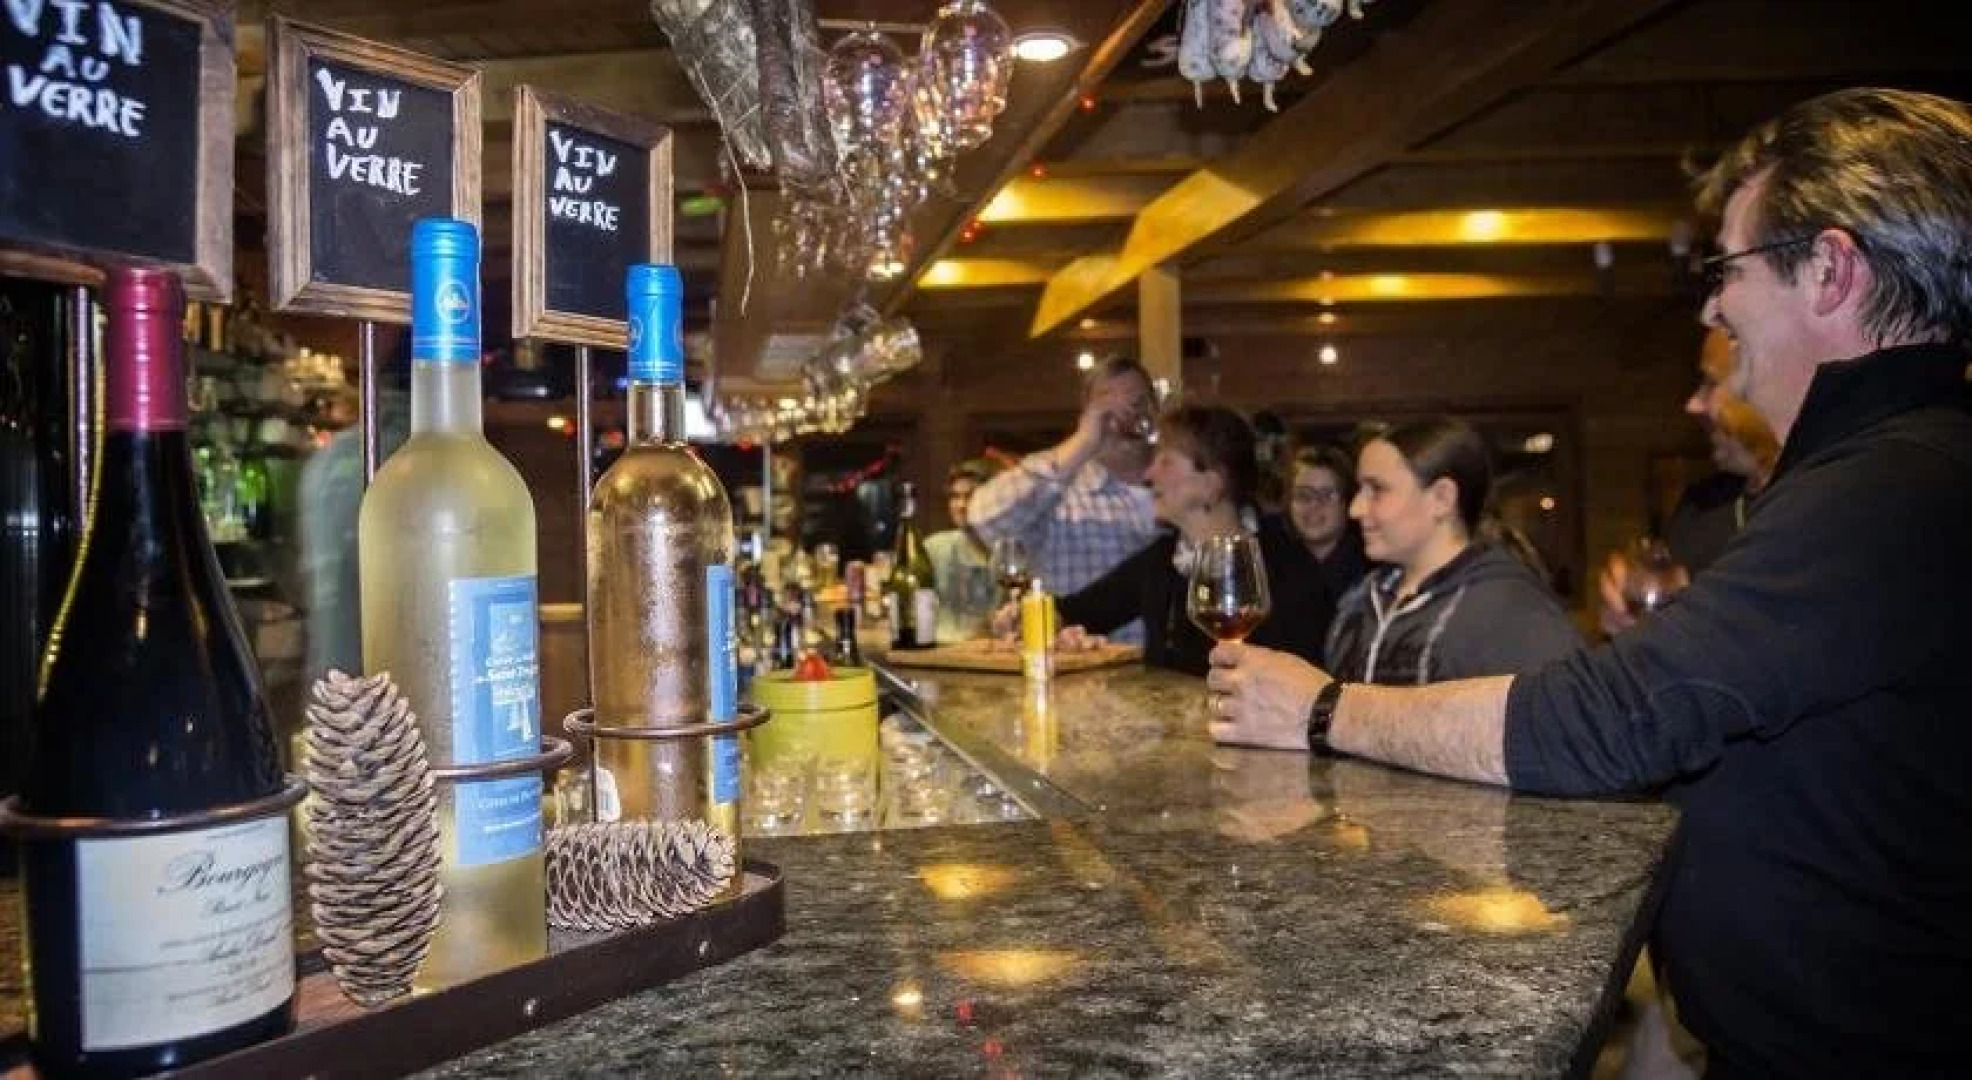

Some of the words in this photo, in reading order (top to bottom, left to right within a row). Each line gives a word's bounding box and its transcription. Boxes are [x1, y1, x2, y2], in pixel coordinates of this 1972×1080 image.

[4, 0, 142, 65] VIN
[41, 44, 110, 82] AU
[8, 65, 147, 136] VERRE
[316, 68, 402, 118] VIN
[326, 116, 379, 149] AU
[326, 142, 423, 196] VERRE
[554, 166, 593, 193] AU
[548, 196, 621, 231] VERRE
